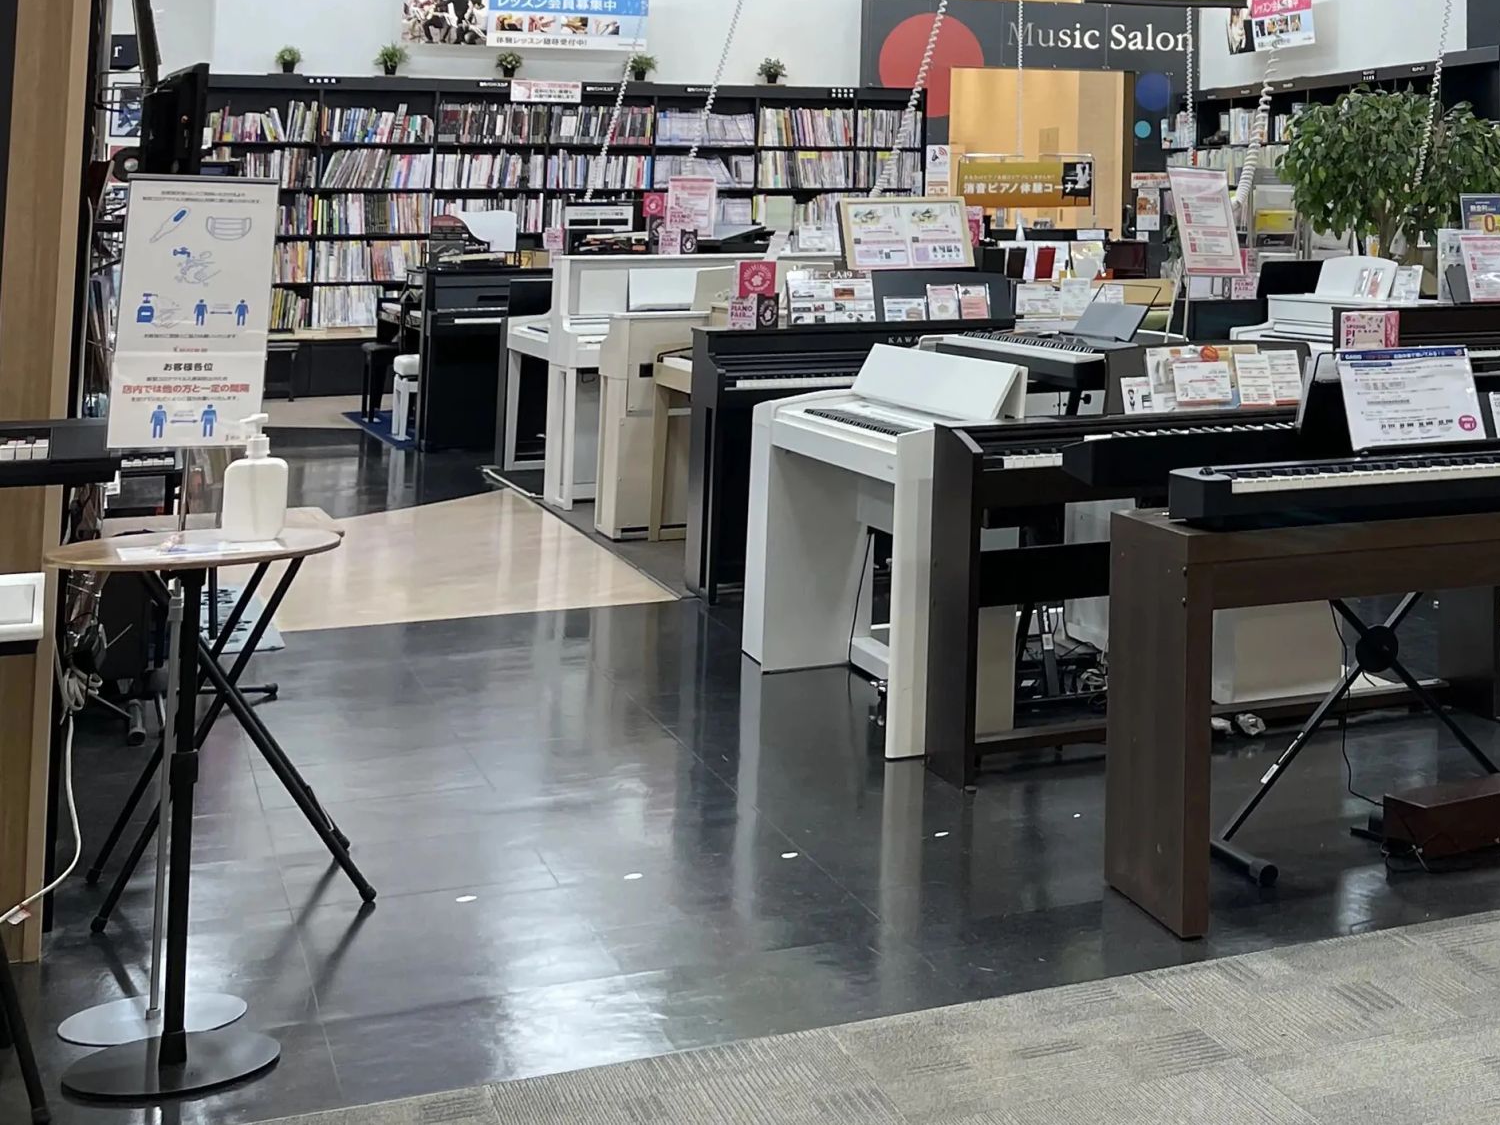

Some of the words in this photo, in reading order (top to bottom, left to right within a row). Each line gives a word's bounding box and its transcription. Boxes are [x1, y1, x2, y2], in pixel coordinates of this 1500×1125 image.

[1007, 22, 1100, 49] Music
[1110, 23, 1194, 51] Salon
[963, 182, 1085, 194] 消音ピアノ体験コーナー
[163, 363, 213, 372] お客様各位
[122, 383, 250, 394] 店内では他の方と一定の間隔
